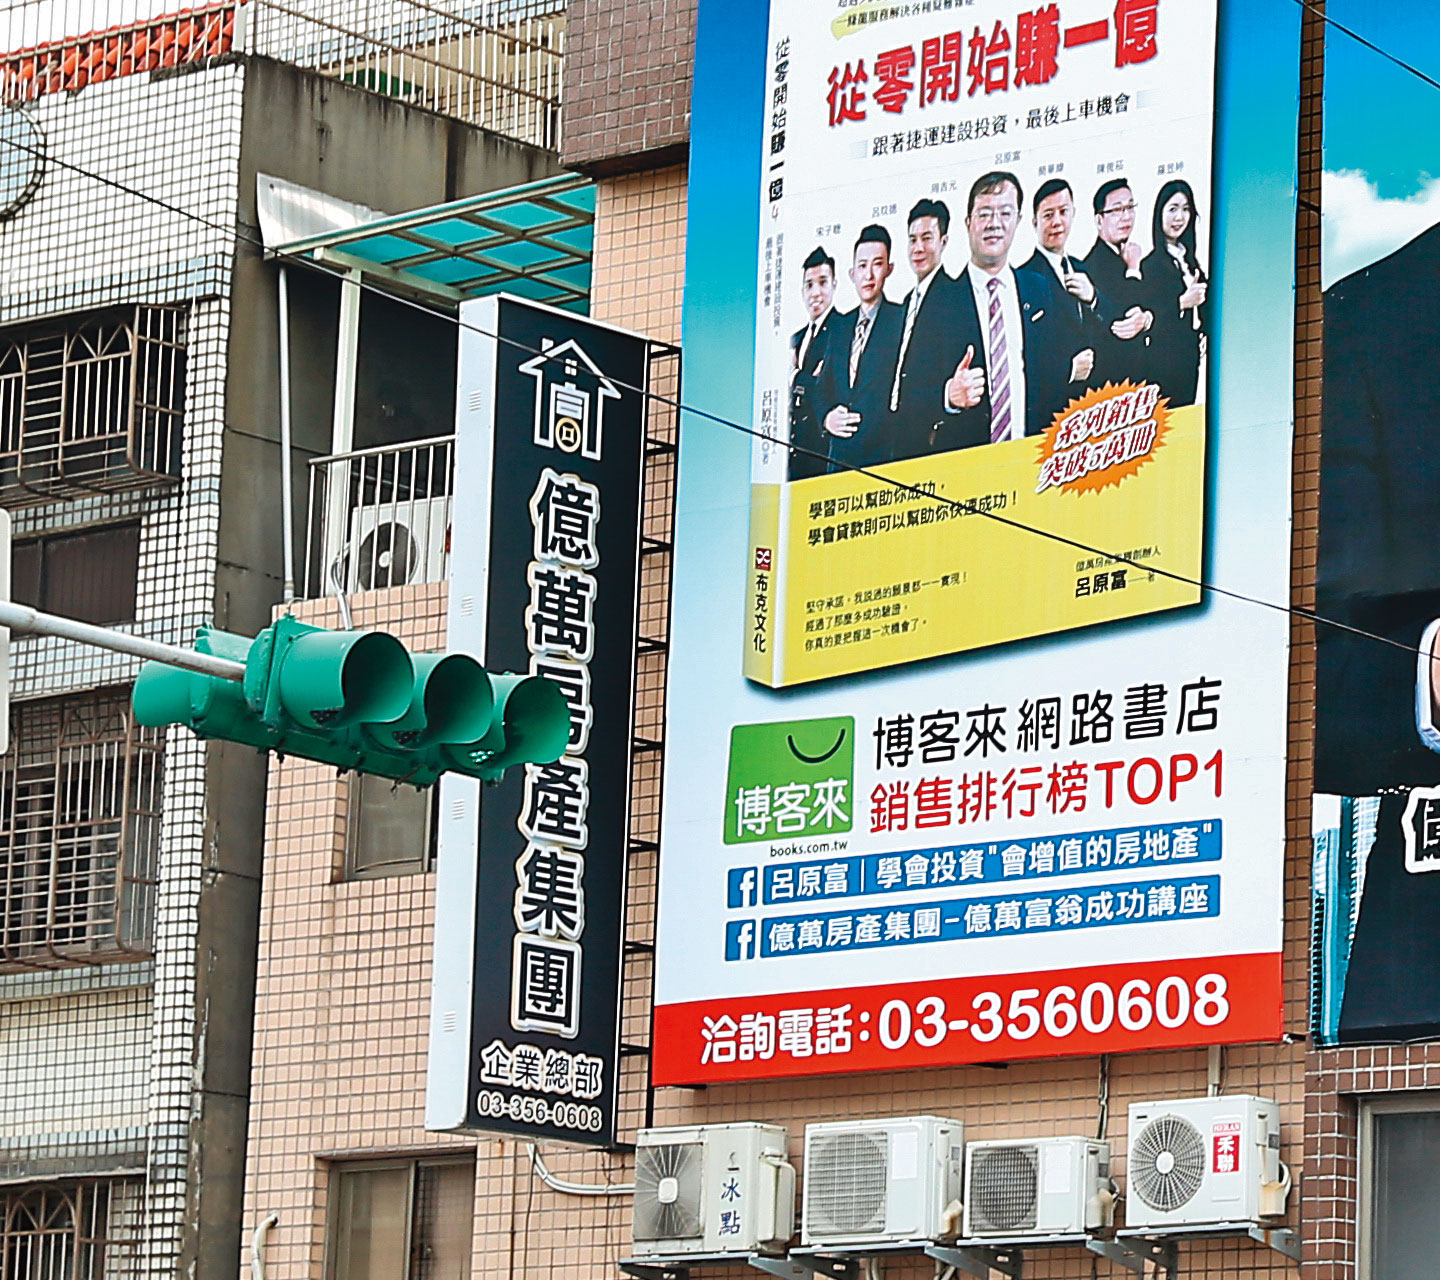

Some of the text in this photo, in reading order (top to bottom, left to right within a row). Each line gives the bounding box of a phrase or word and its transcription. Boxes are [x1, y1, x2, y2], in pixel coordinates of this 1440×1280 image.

[872, 92, 1132, 158] 跟著捷運建設投資，最後上車機會
[1056, 384, 1160, 450] 系列銷售
[1035, 419, 1159, 493] 突破5萬冊
[753, 575, 767, 653] 布克文化
[1075, 569, 1127, 598] 呂原富
[872, 676, 1223, 770] 博客來網路書店
[735, 780, 850, 837] 博客來
[869, 749, 1224, 835] 銷售排行榜TOP1
[770, 841, 848, 858] books.com.tw
[770, 863, 849, 902] 呂原富
[769, 880, 1210, 952] 億萬房產集團-億萬富翁成功講座
[700, 973, 1231, 1066] 洽詢電話:03-3560608
[479, 1038, 602, 1098] 企業總部
[476, 1090, 602, 1130] 03-356-0608
[719, 1177, 742, 1236] 冰點
